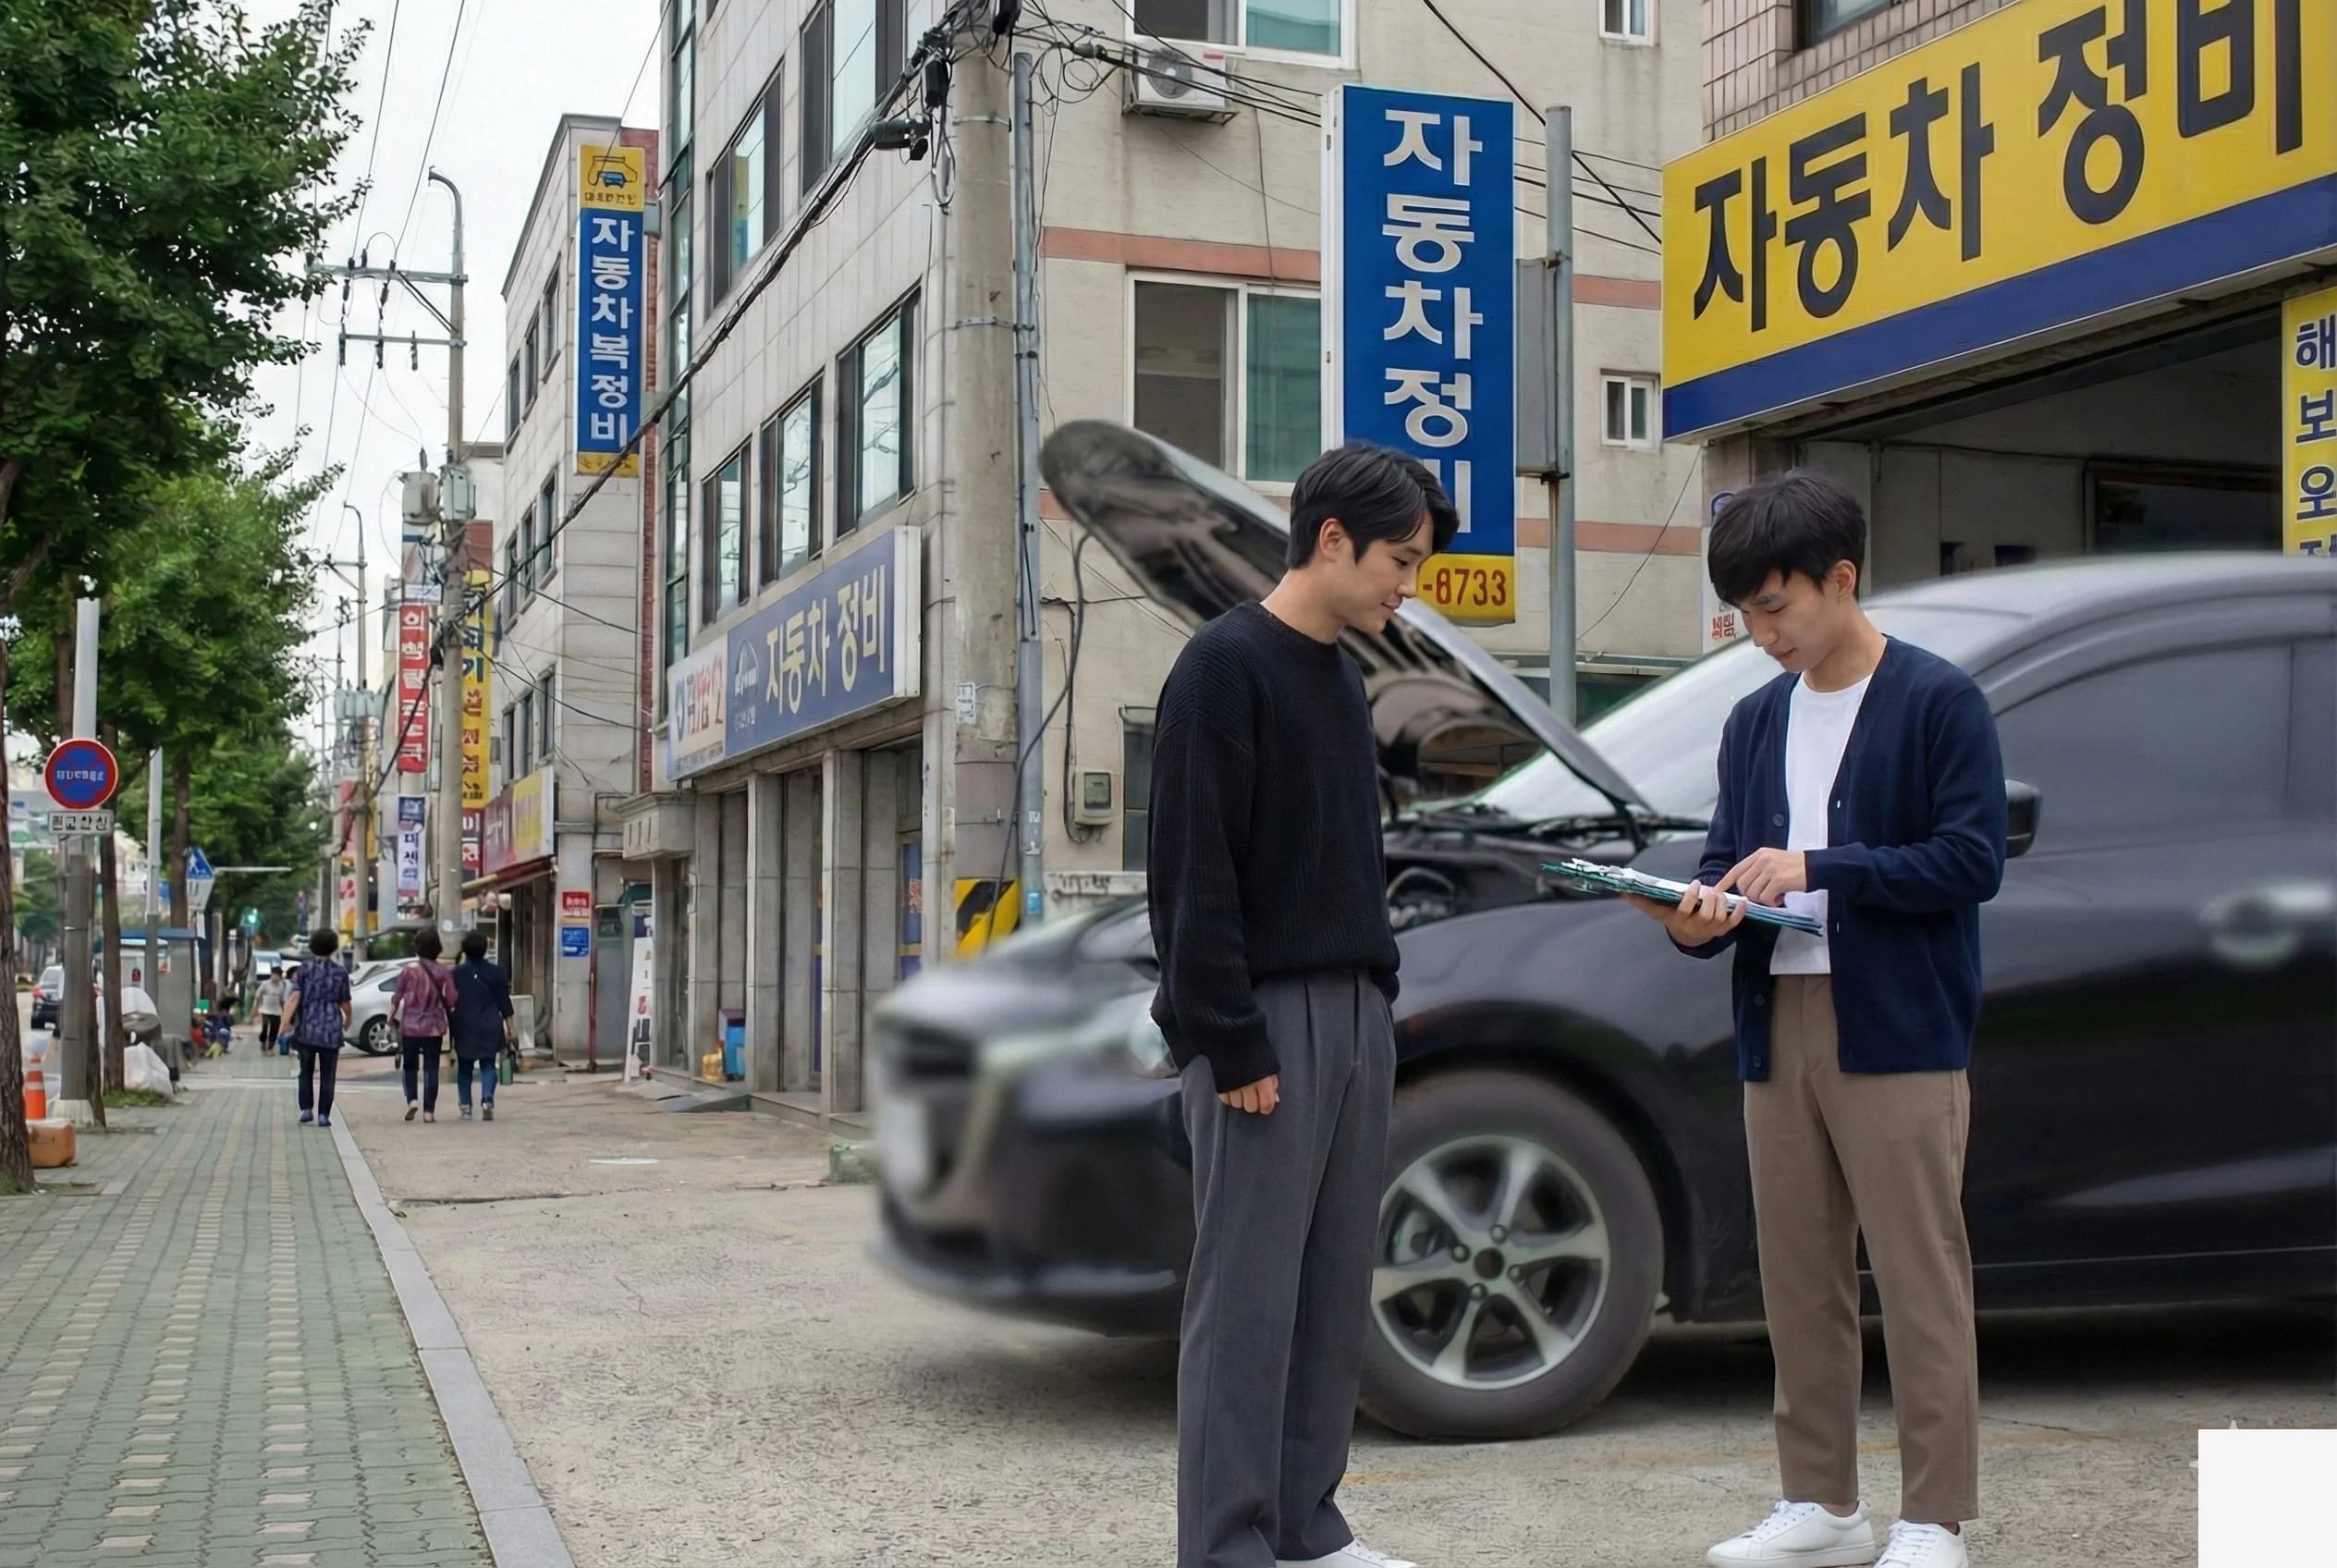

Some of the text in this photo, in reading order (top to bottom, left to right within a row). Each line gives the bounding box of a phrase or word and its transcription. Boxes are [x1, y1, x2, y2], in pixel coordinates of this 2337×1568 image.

[1693, 0, 2303, 333] 자동차 정비
[837, 563, 886, 692] 정비
